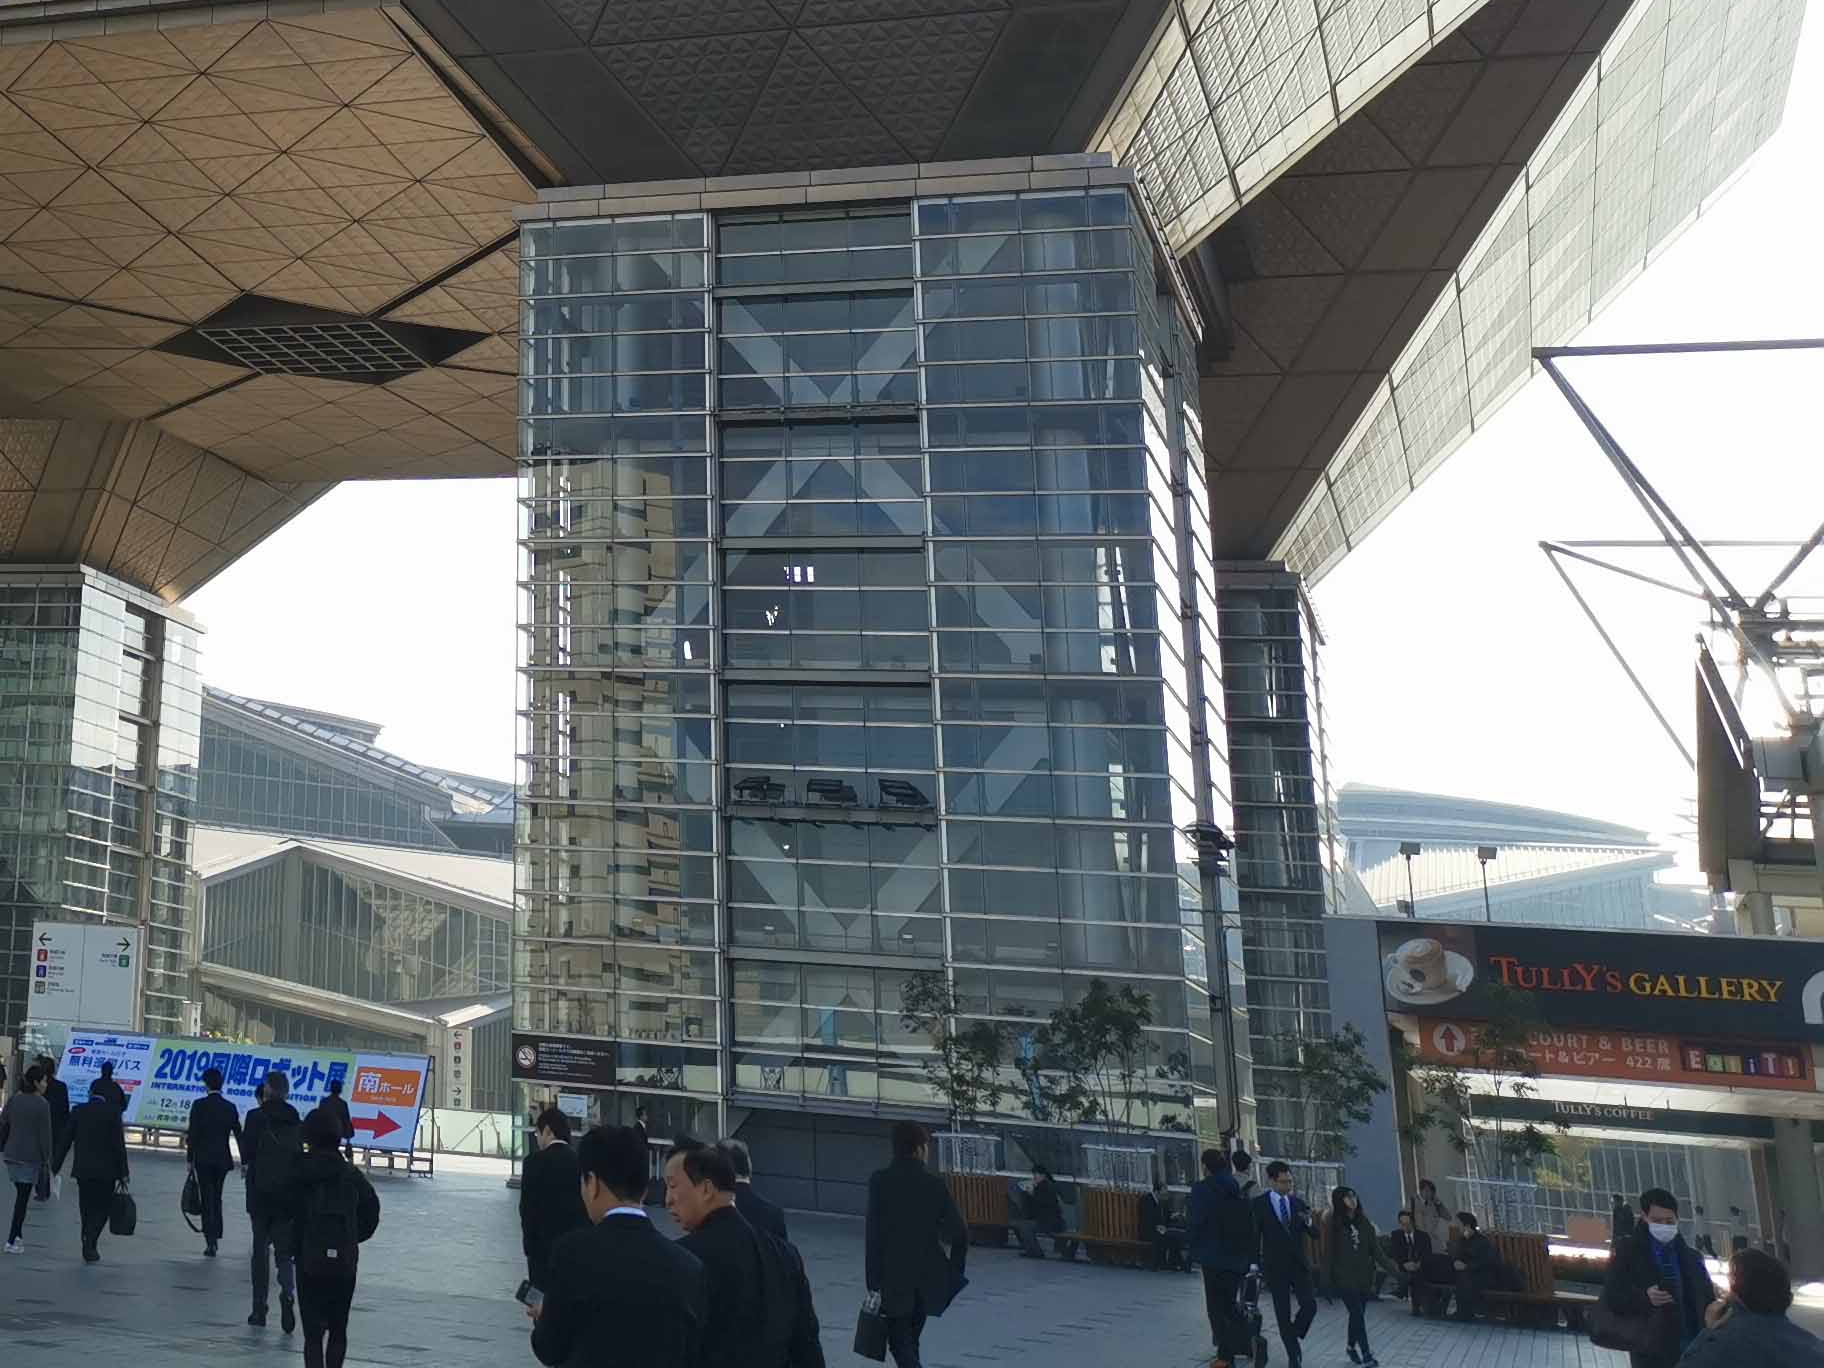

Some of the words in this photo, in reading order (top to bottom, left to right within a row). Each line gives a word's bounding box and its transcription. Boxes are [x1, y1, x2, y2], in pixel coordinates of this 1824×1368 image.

[1628, 972, 1785, 1003] GALLERY
[1599, 1036, 1612, 1051] &
[1622, 1038, 1670, 1055] BEER
[357, 1072, 415, 1095] 南ホール
[1603, 1107, 1656, 1121] COFFEE
